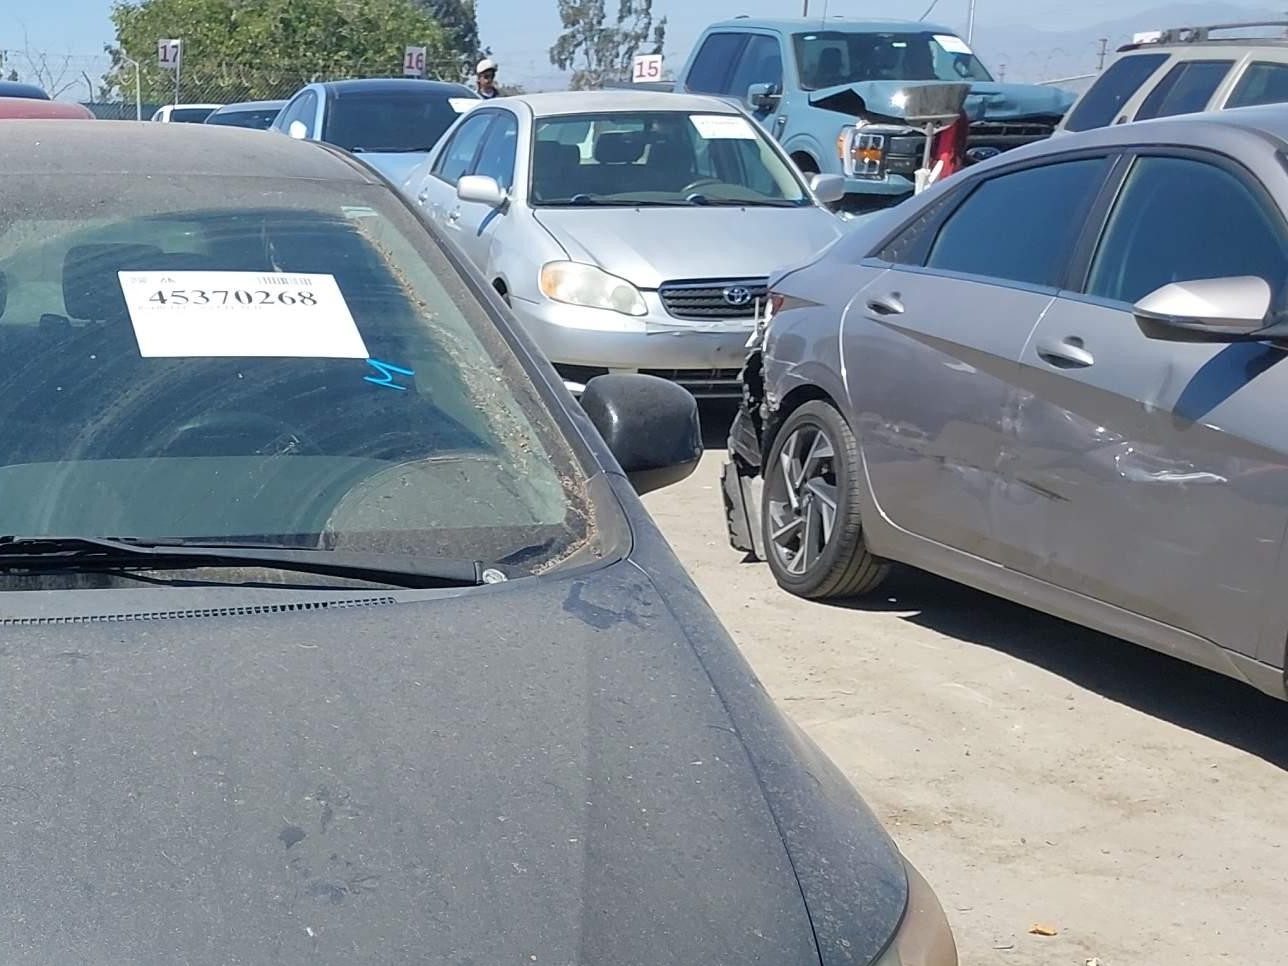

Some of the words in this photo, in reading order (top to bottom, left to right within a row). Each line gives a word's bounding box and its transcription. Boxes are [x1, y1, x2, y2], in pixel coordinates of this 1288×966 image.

[159, 44, 179, 63] 17
[405, 52, 425, 71] 16
[635, 60, 659, 78] 15
[149, 289, 318, 306] 45370268
